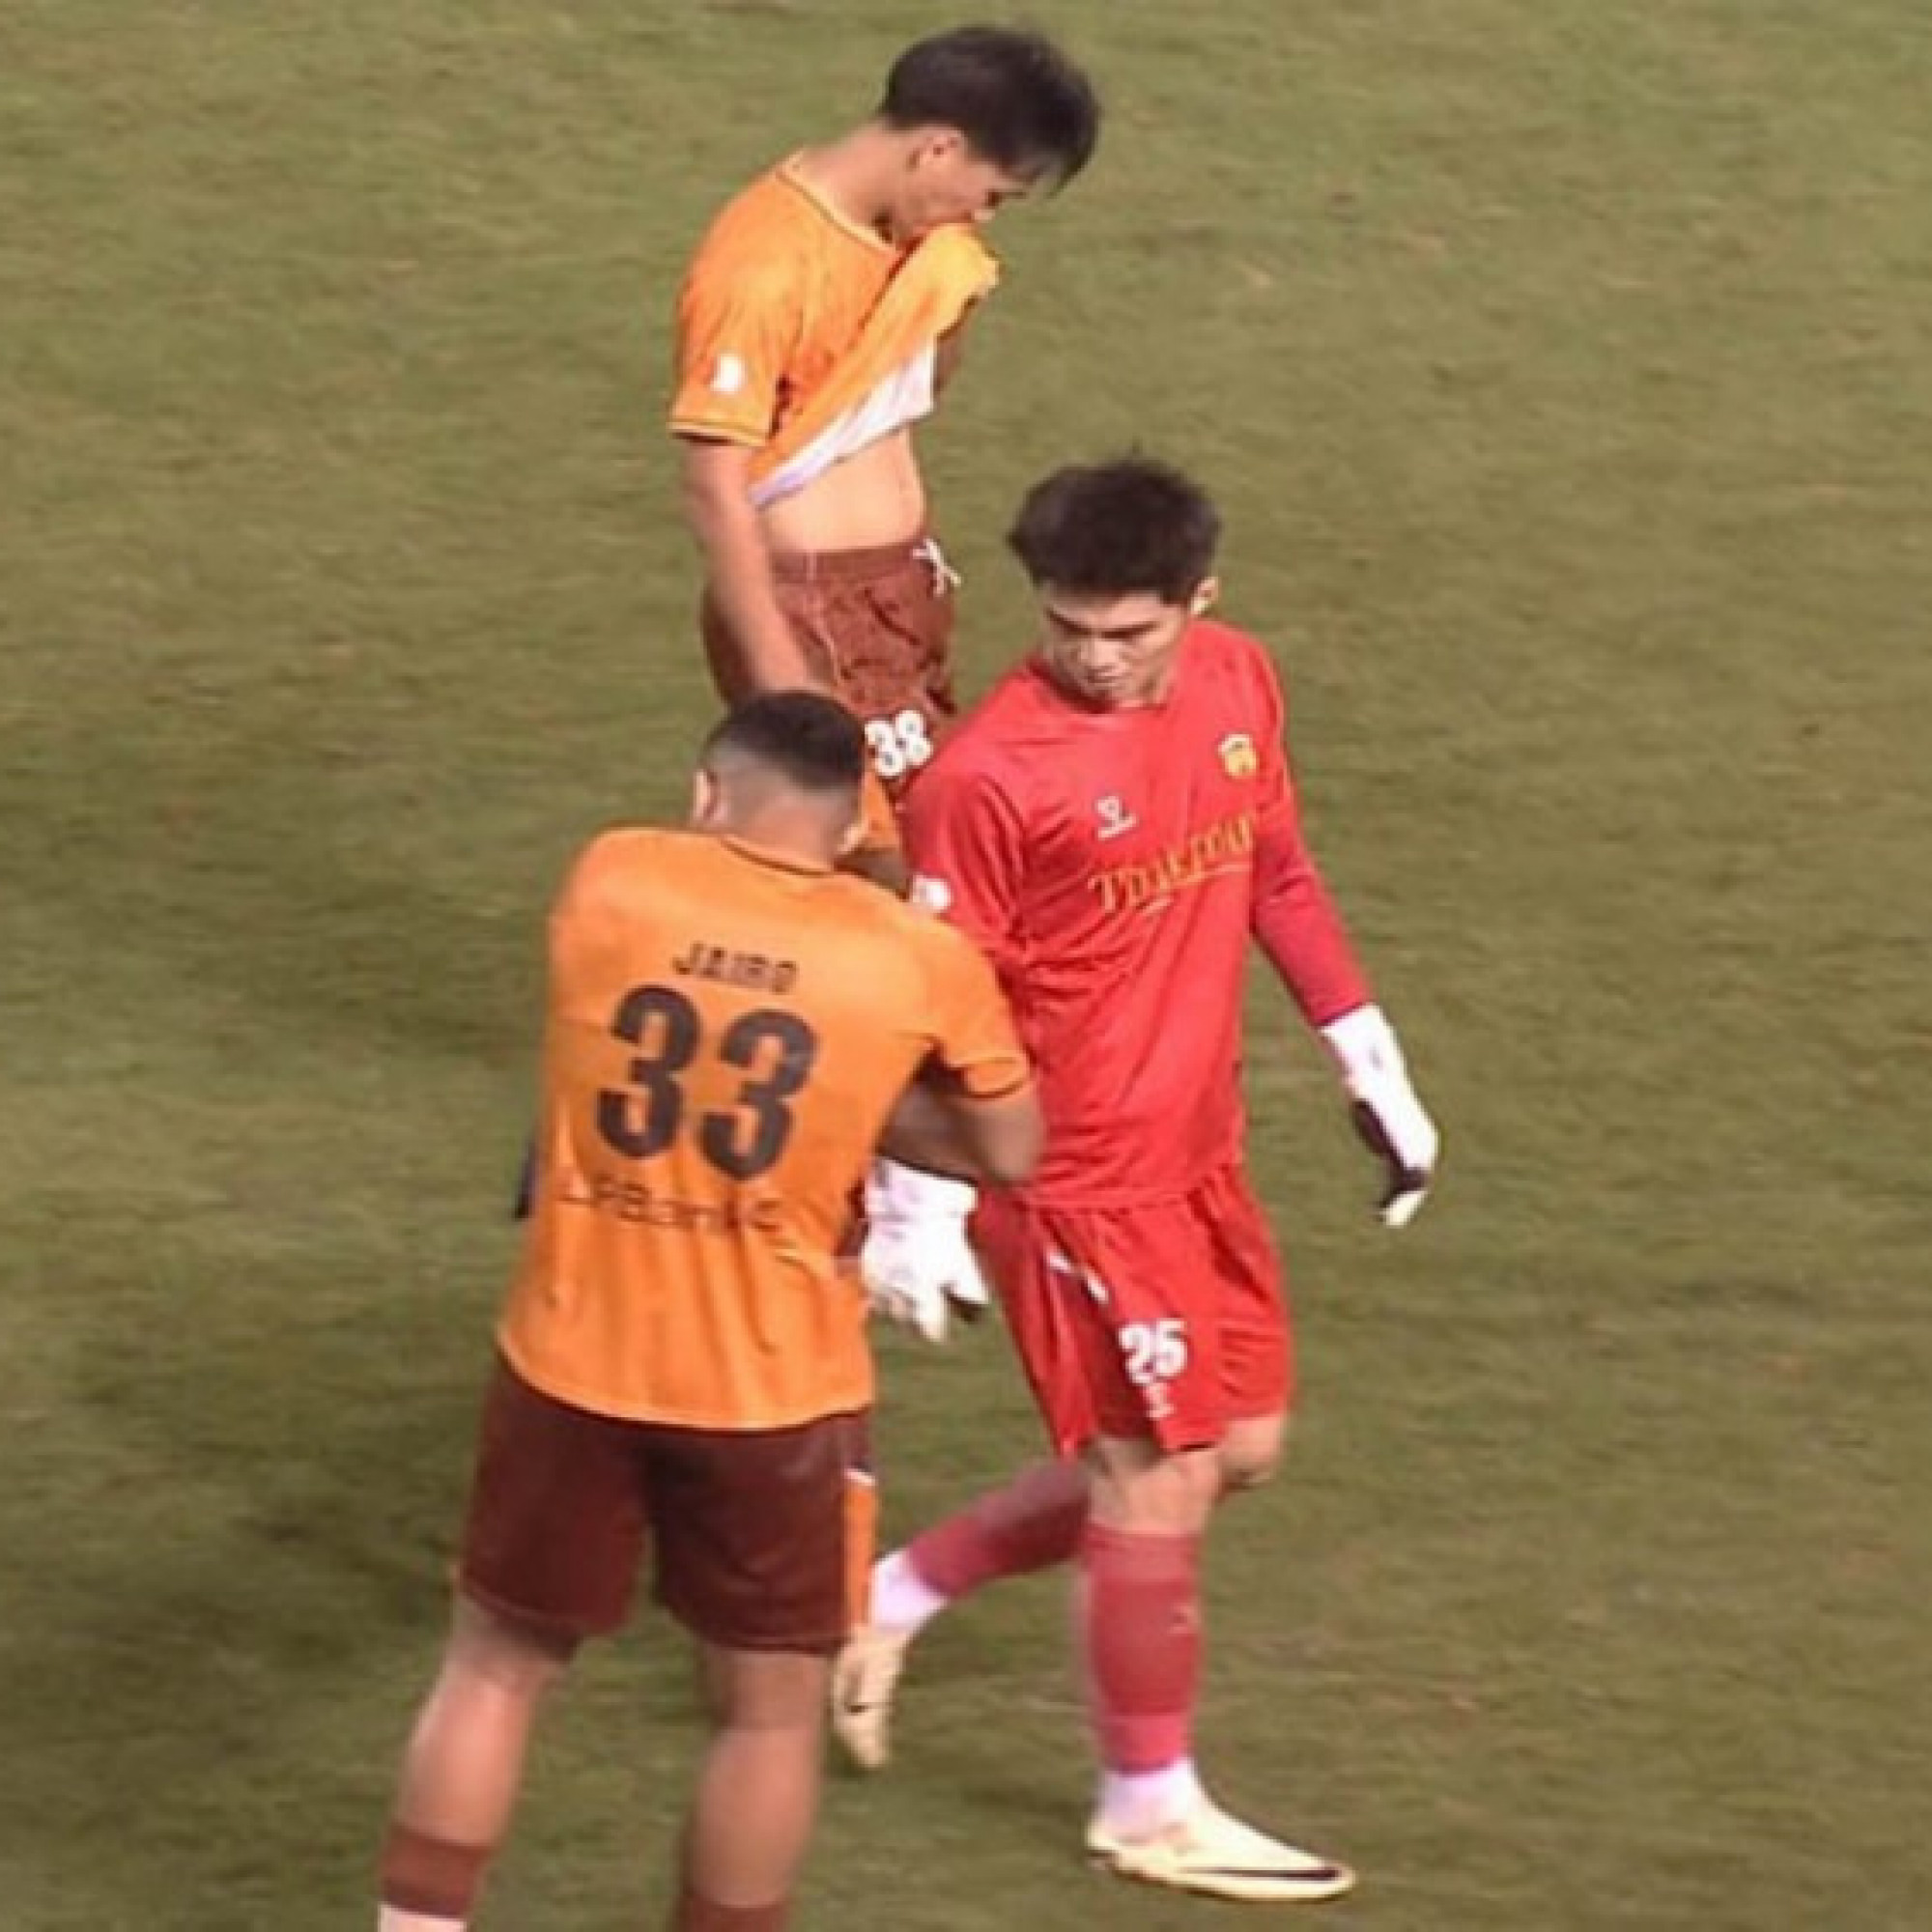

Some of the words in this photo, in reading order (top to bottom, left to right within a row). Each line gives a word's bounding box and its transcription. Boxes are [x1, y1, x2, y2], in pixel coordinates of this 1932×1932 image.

[865, 709, 933, 777] 38
[596, 983, 818, 1181] 33
[1119, 1317, 1188, 1385] 25
